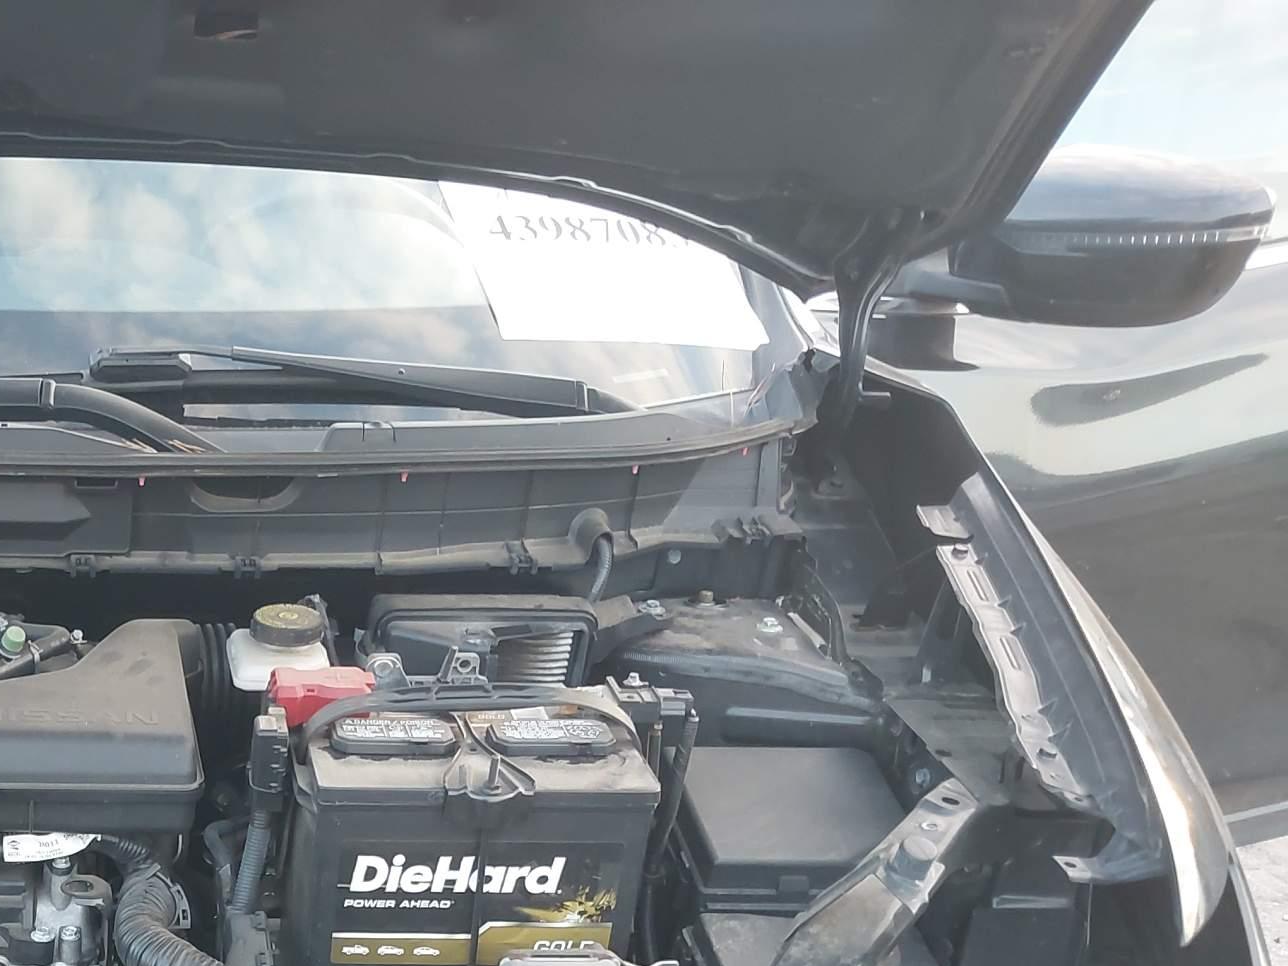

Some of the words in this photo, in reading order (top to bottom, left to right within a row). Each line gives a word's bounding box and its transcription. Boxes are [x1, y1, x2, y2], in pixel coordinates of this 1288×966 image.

[489, 215, 690, 247] 4398708
[349, 853, 567, 894] DieHard
[343, 898, 396, 909] POWER
[399, 898, 452, 909] AHEAD
